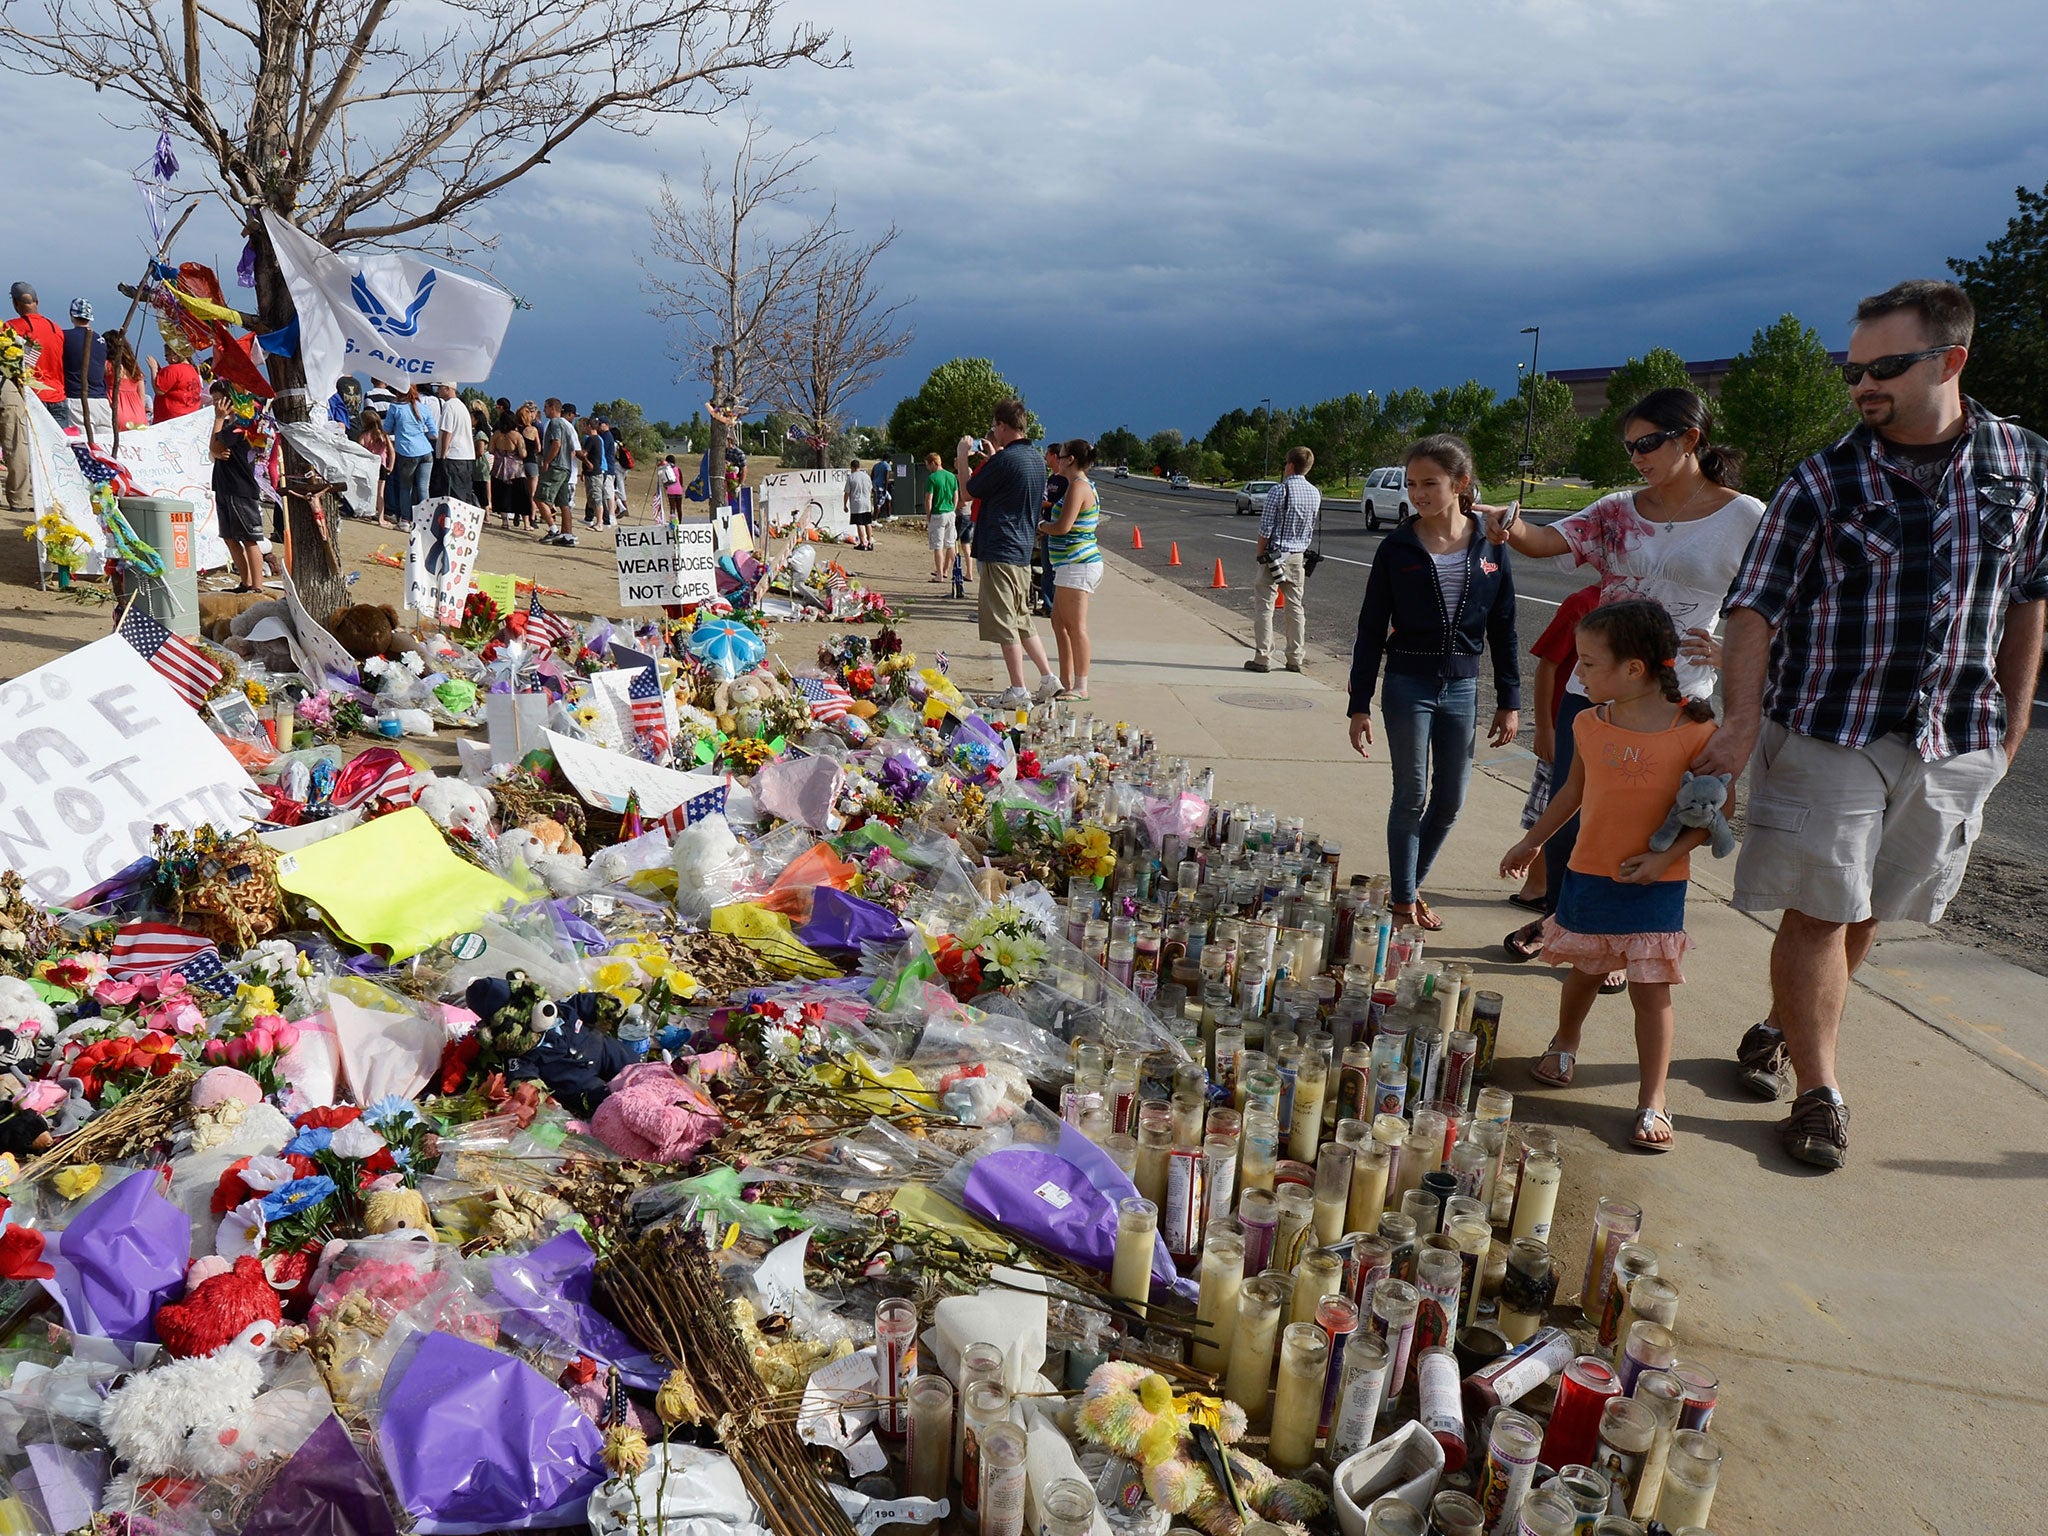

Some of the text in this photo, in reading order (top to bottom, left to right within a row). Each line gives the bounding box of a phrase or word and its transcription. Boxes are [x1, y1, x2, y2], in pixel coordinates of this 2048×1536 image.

[765, 475, 789, 487] WE
[615, 530, 712, 547] REAL HEROES
[618, 556, 714, 574] WEAR BADGES
[629, 582, 710, 600] NOT CAPES
[0, 754, 151, 870] NOT
[874, 1510, 895, 1518] 190
